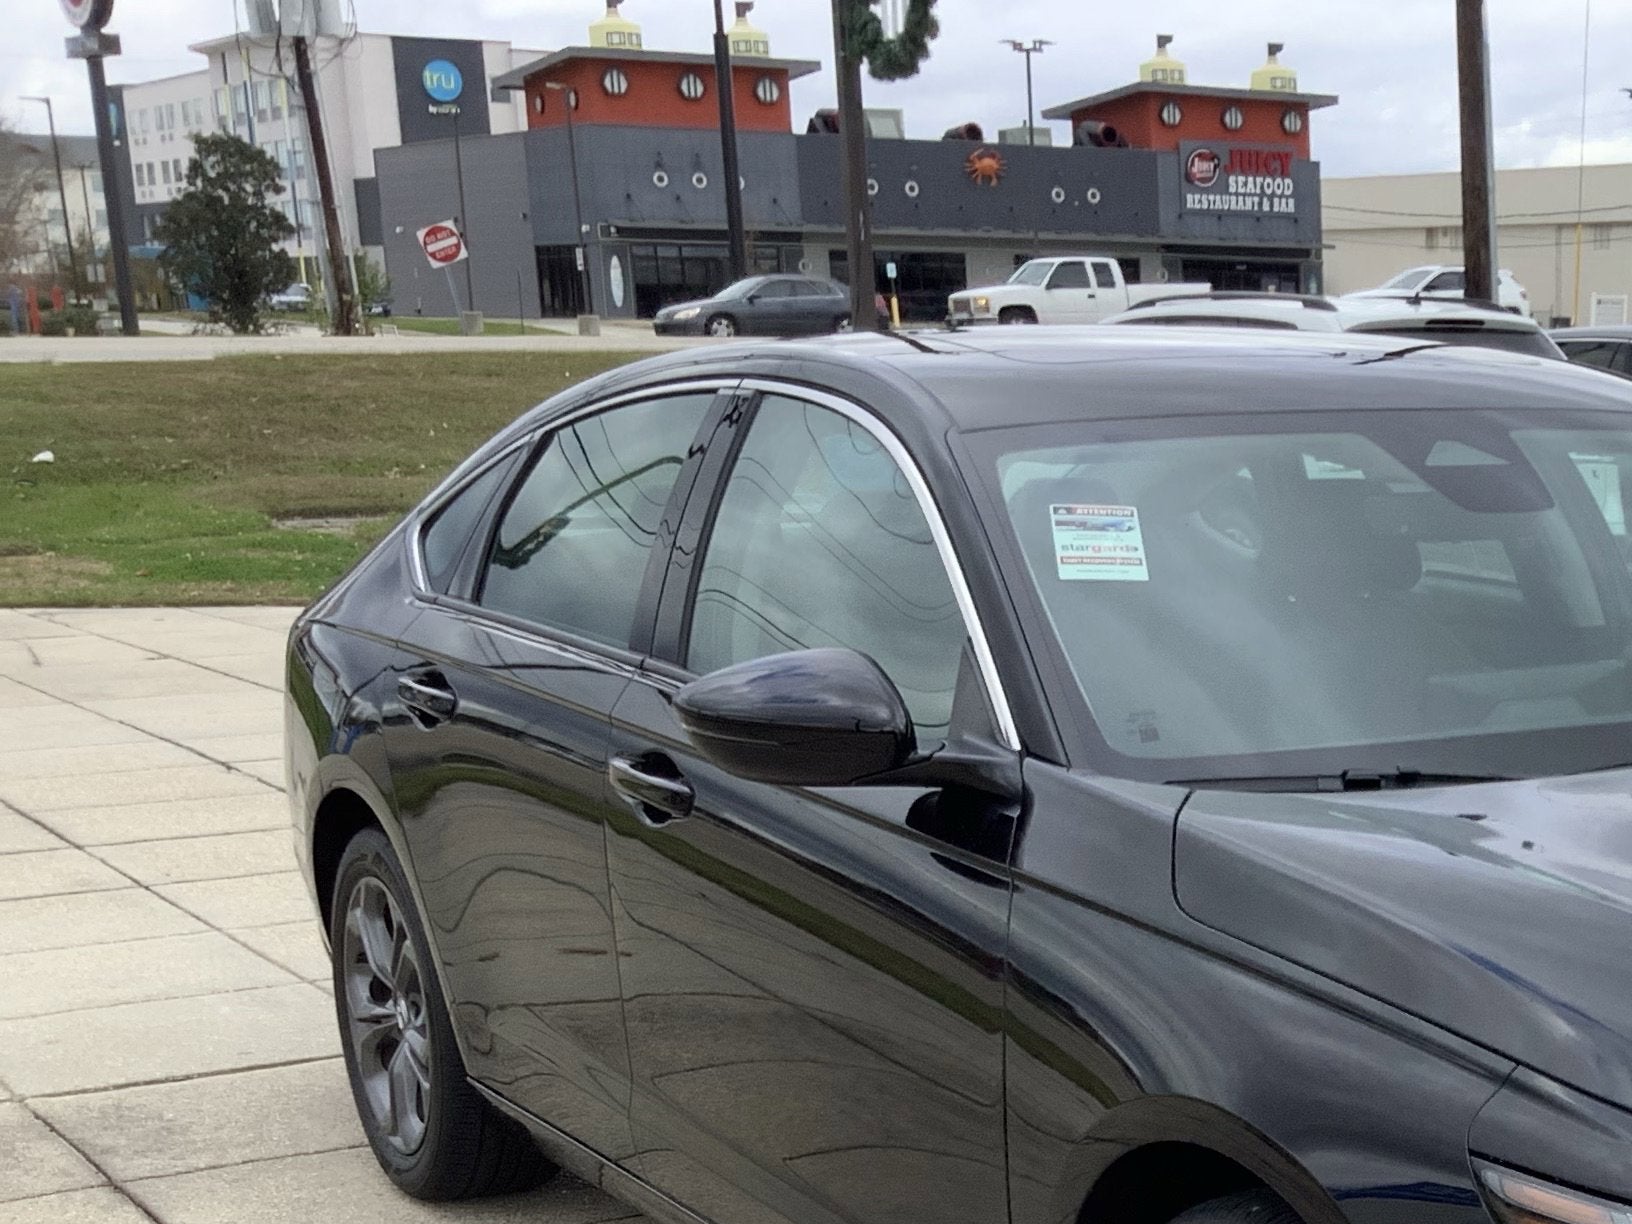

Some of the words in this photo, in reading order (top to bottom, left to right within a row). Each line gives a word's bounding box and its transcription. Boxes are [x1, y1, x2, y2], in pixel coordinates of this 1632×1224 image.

[425, 69, 455, 89] tru
[1223, 148, 1293, 176] JUICY
[1228, 175, 1294, 195] SEAFOOD
[1186, 193, 1260, 211] RESTAURANT
[1262, 197, 1271, 212] &
[1272, 197, 1295, 213] BAR
